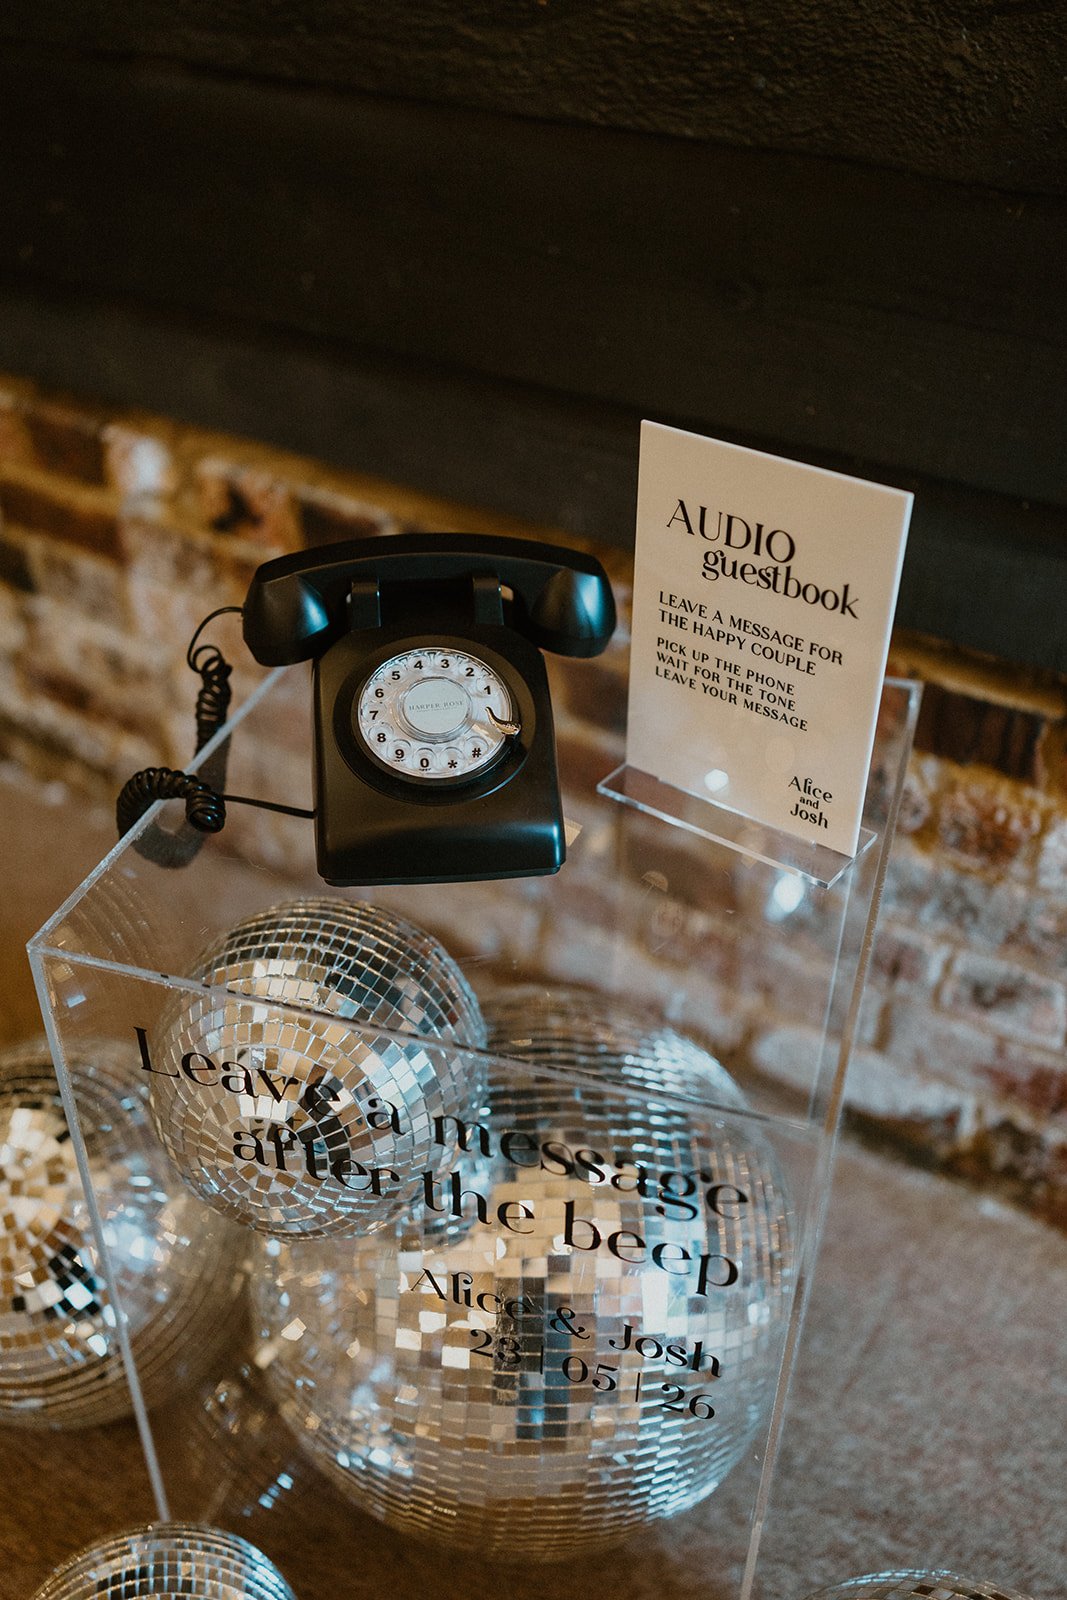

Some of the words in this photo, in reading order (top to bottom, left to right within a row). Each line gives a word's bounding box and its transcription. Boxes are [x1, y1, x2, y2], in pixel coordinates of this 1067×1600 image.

[666, 499, 796, 563] AUDIO
[701, 550, 860, 620] guestbook
[659, 591, 707, 619] LEAVE
[712, 610, 723, 625] A
[729, 615, 804, 652] MESSAGE
[809, 642, 843, 665] FOR
[659, 609, 688, 631] THE
[693, 621, 746, 650] HAPPY
[751, 642, 816, 676] COUPLE
[391, 671, 401, 680] 5
[413, 660, 423, 670] 4
[440, 659, 450, 669] 3
[465, 667, 475, 677] 2
[657, 637, 686, 656] PICK
[692, 649, 709, 663] UP
[715, 657, 741, 676] THE
[746, 669, 794, 695] PHONE
[375, 688, 384, 698] 6
[483, 686, 491, 695] 1
[656, 651, 688, 671] WAIT
[694, 665, 720, 683] FOR
[727, 677, 753, 696] THE
[759, 688, 796, 711] TONE
[655, 666, 696, 690] LEAVE
[701, 682, 737, 705] YOUR
[743, 698, 808, 731] MESSAGE
[369, 710, 379, 720] 7
[377, 733, 387, 743] 8
[395, 749, 405, 759] 9
[420, 758, 430, 768] 0
[788, 776, 833, 803] Alice
[790, 803, 829, 829] Josh
[799, 796, 819, 810] and
[133, 1026, 342, 1117] Leave
[366, 1098, 406, 1136] a
[432, 1114, 749, 1222] message
[233, 1127, 400, 1197] after
[421, 1170, 535, 1235] the
[563, 1200, 739, 1297] beep
[411, 1268, 531, 1321] Alice
[549, 1307, 590, 1340] &
[609, 1324, 722, 1378] Josh
[470, 1329, 522, 1365] 23
[562, 1356, 618, 1393] 05
[660, 1383, 716, 1421] 26
